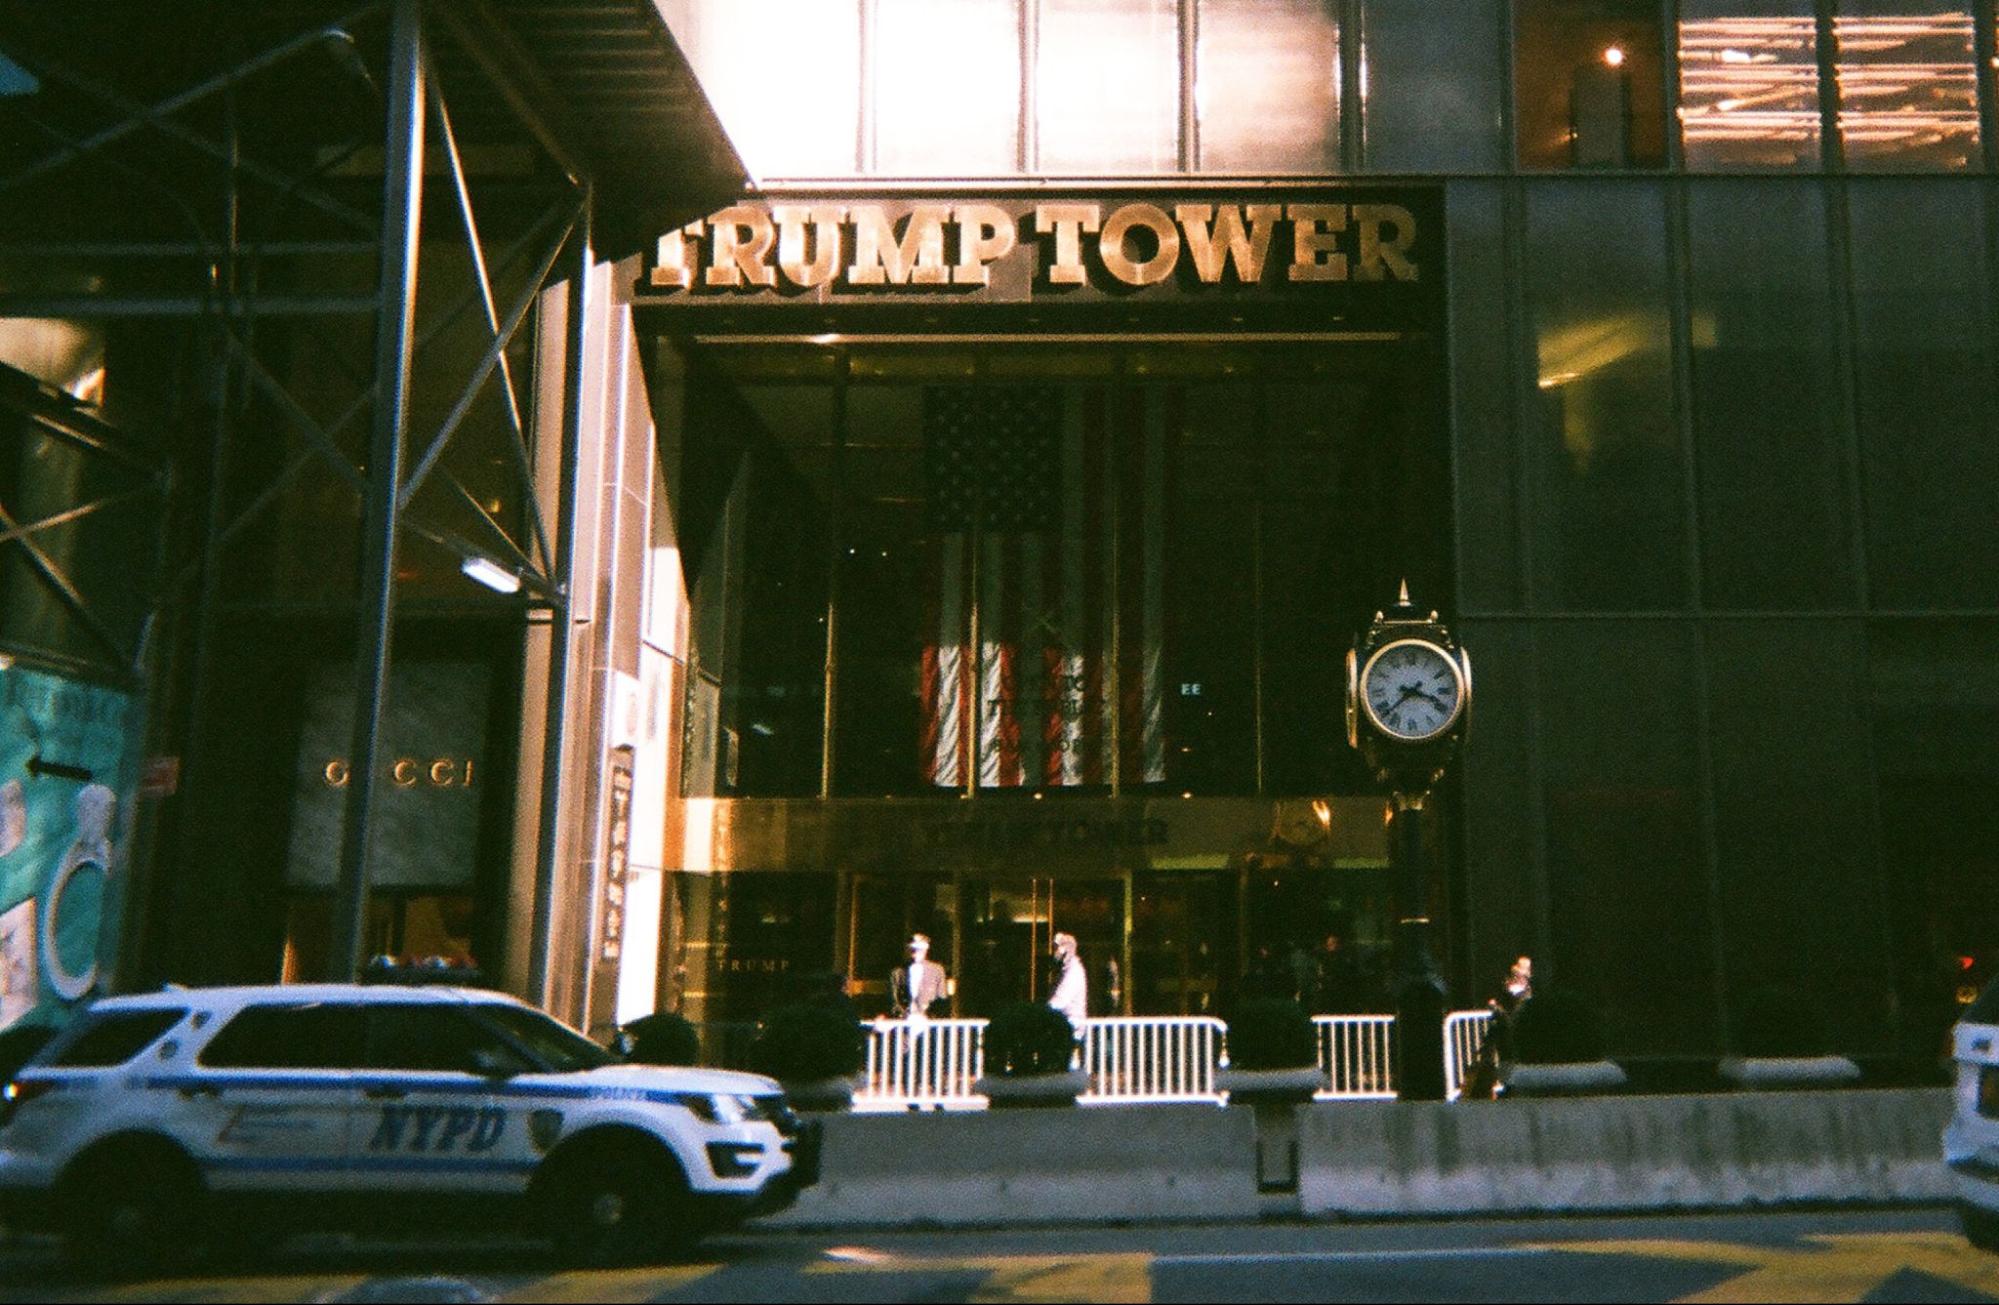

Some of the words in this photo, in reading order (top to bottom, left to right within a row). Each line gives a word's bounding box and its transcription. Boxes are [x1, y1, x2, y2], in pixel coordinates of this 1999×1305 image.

[1035, 203, 1419, 285] TOWER
[325, 760, 474, 786] GCCI
[715, 958, 790, 973] TRUMP
[367, 1105, 507, 1152] NYPD
